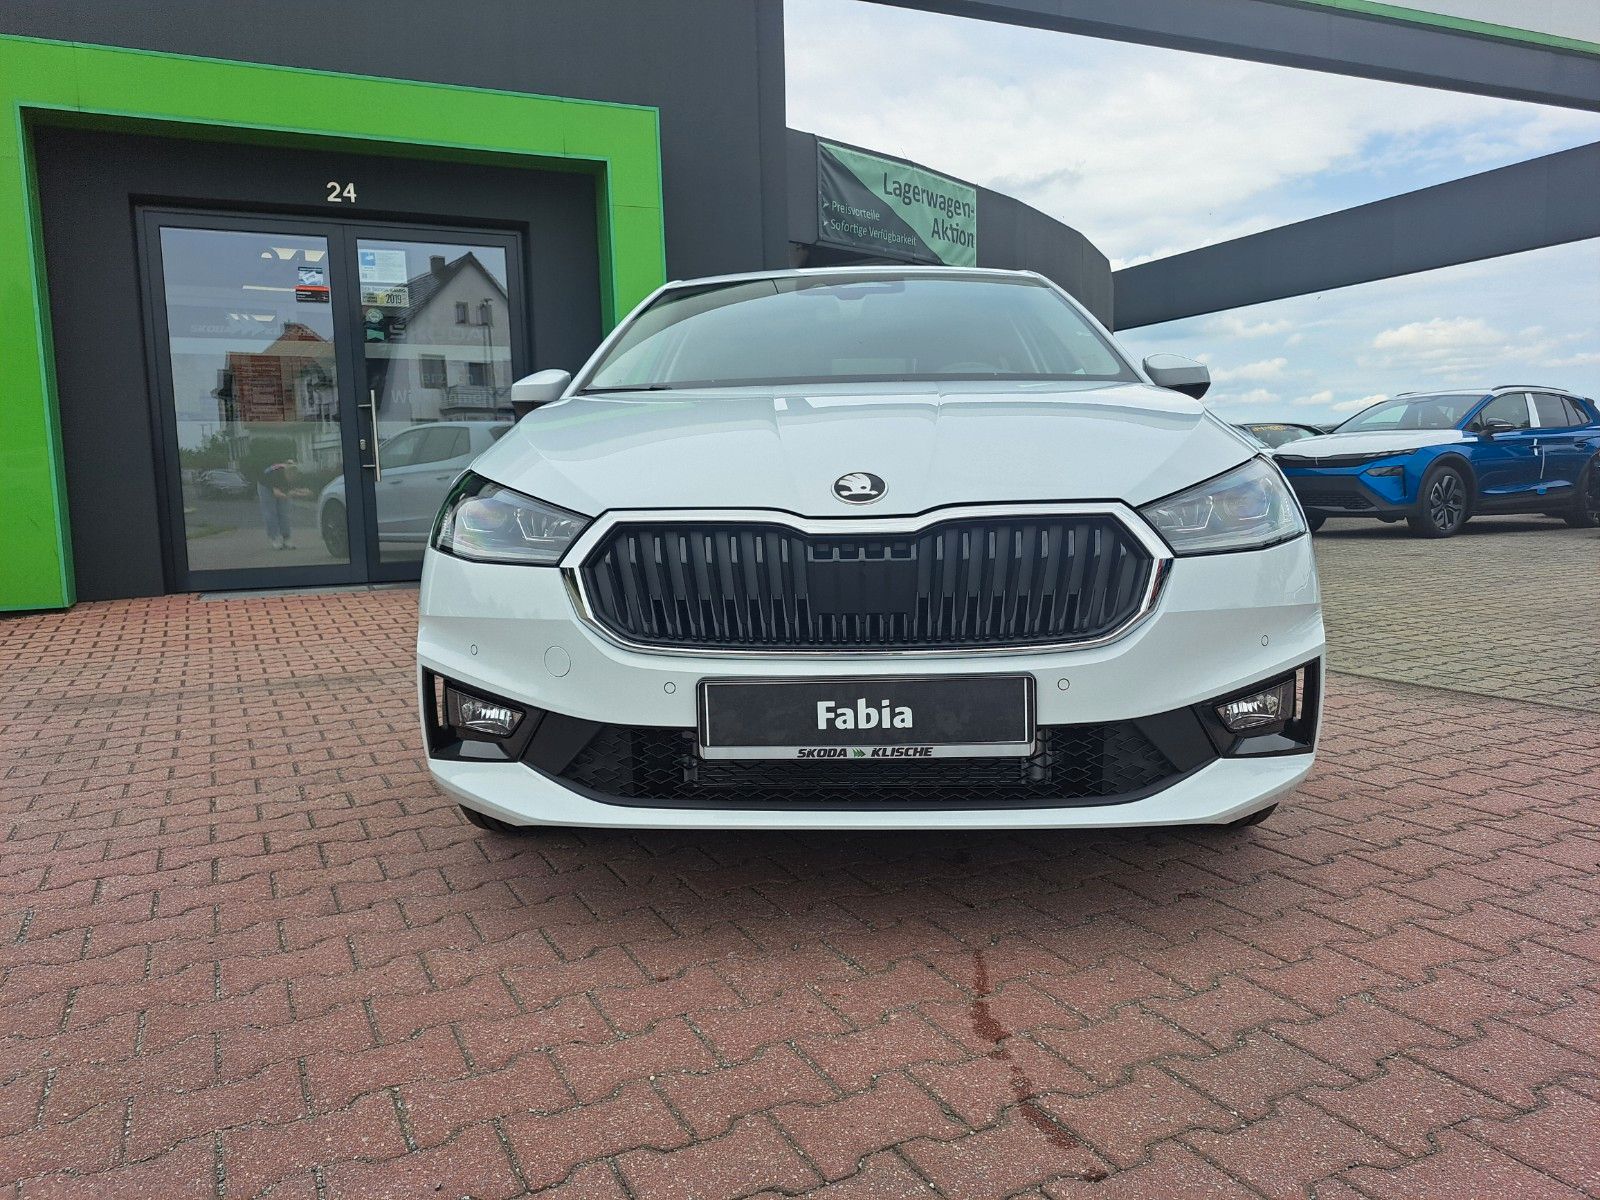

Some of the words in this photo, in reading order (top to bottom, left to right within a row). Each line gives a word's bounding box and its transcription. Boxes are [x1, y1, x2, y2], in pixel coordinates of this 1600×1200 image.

[326, 181, 357, 203] 24
[883, 172, 975, 218] Lagerwagen-
[831, 200, 881, 222] Preisvorteile
[830, 219, 868, 237] Sofortige
[868, 225, 917, 246] Verfügbarkeit
[931, 217, 975, 249] Aktion
[816, 697, 913, 730] Fabia
[796, 747, 848, 758] SKODA
[870, 746, 934, 758] KLISCHE
